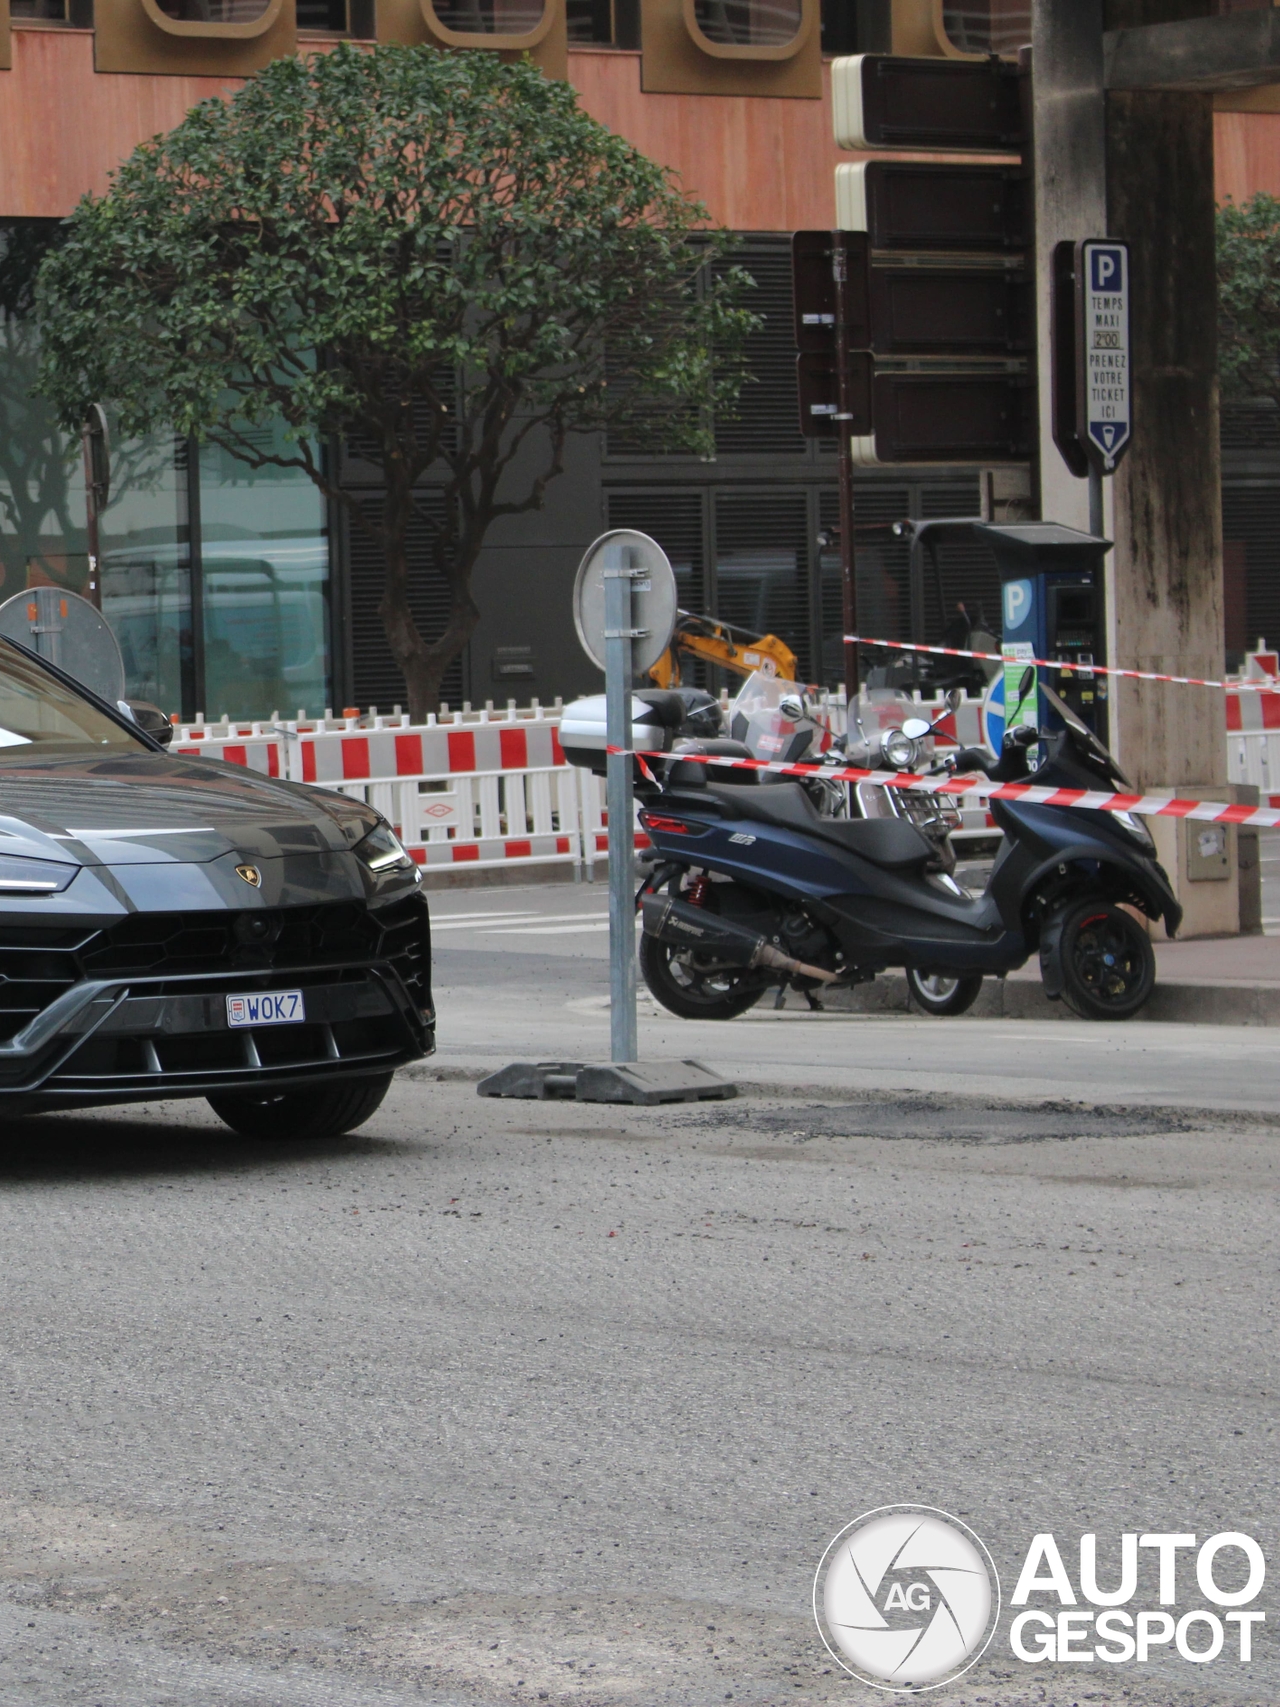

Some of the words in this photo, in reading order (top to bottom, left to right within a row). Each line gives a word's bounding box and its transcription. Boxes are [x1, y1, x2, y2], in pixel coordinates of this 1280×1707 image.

[1099, 255, 1115, 286] P
[1092, 297, 1123, 310] TEMPS
[1095, 314, 1119, 327] MAXI
[1089, 354, 1126, 368] PRENEZ
[1094, 371, 1122, 384] VOTRE
[1092, 388, 1124, 401] TICKET
[1101, 405, 1115, 418] ICI
[1007, 585, 1024, 620] P
